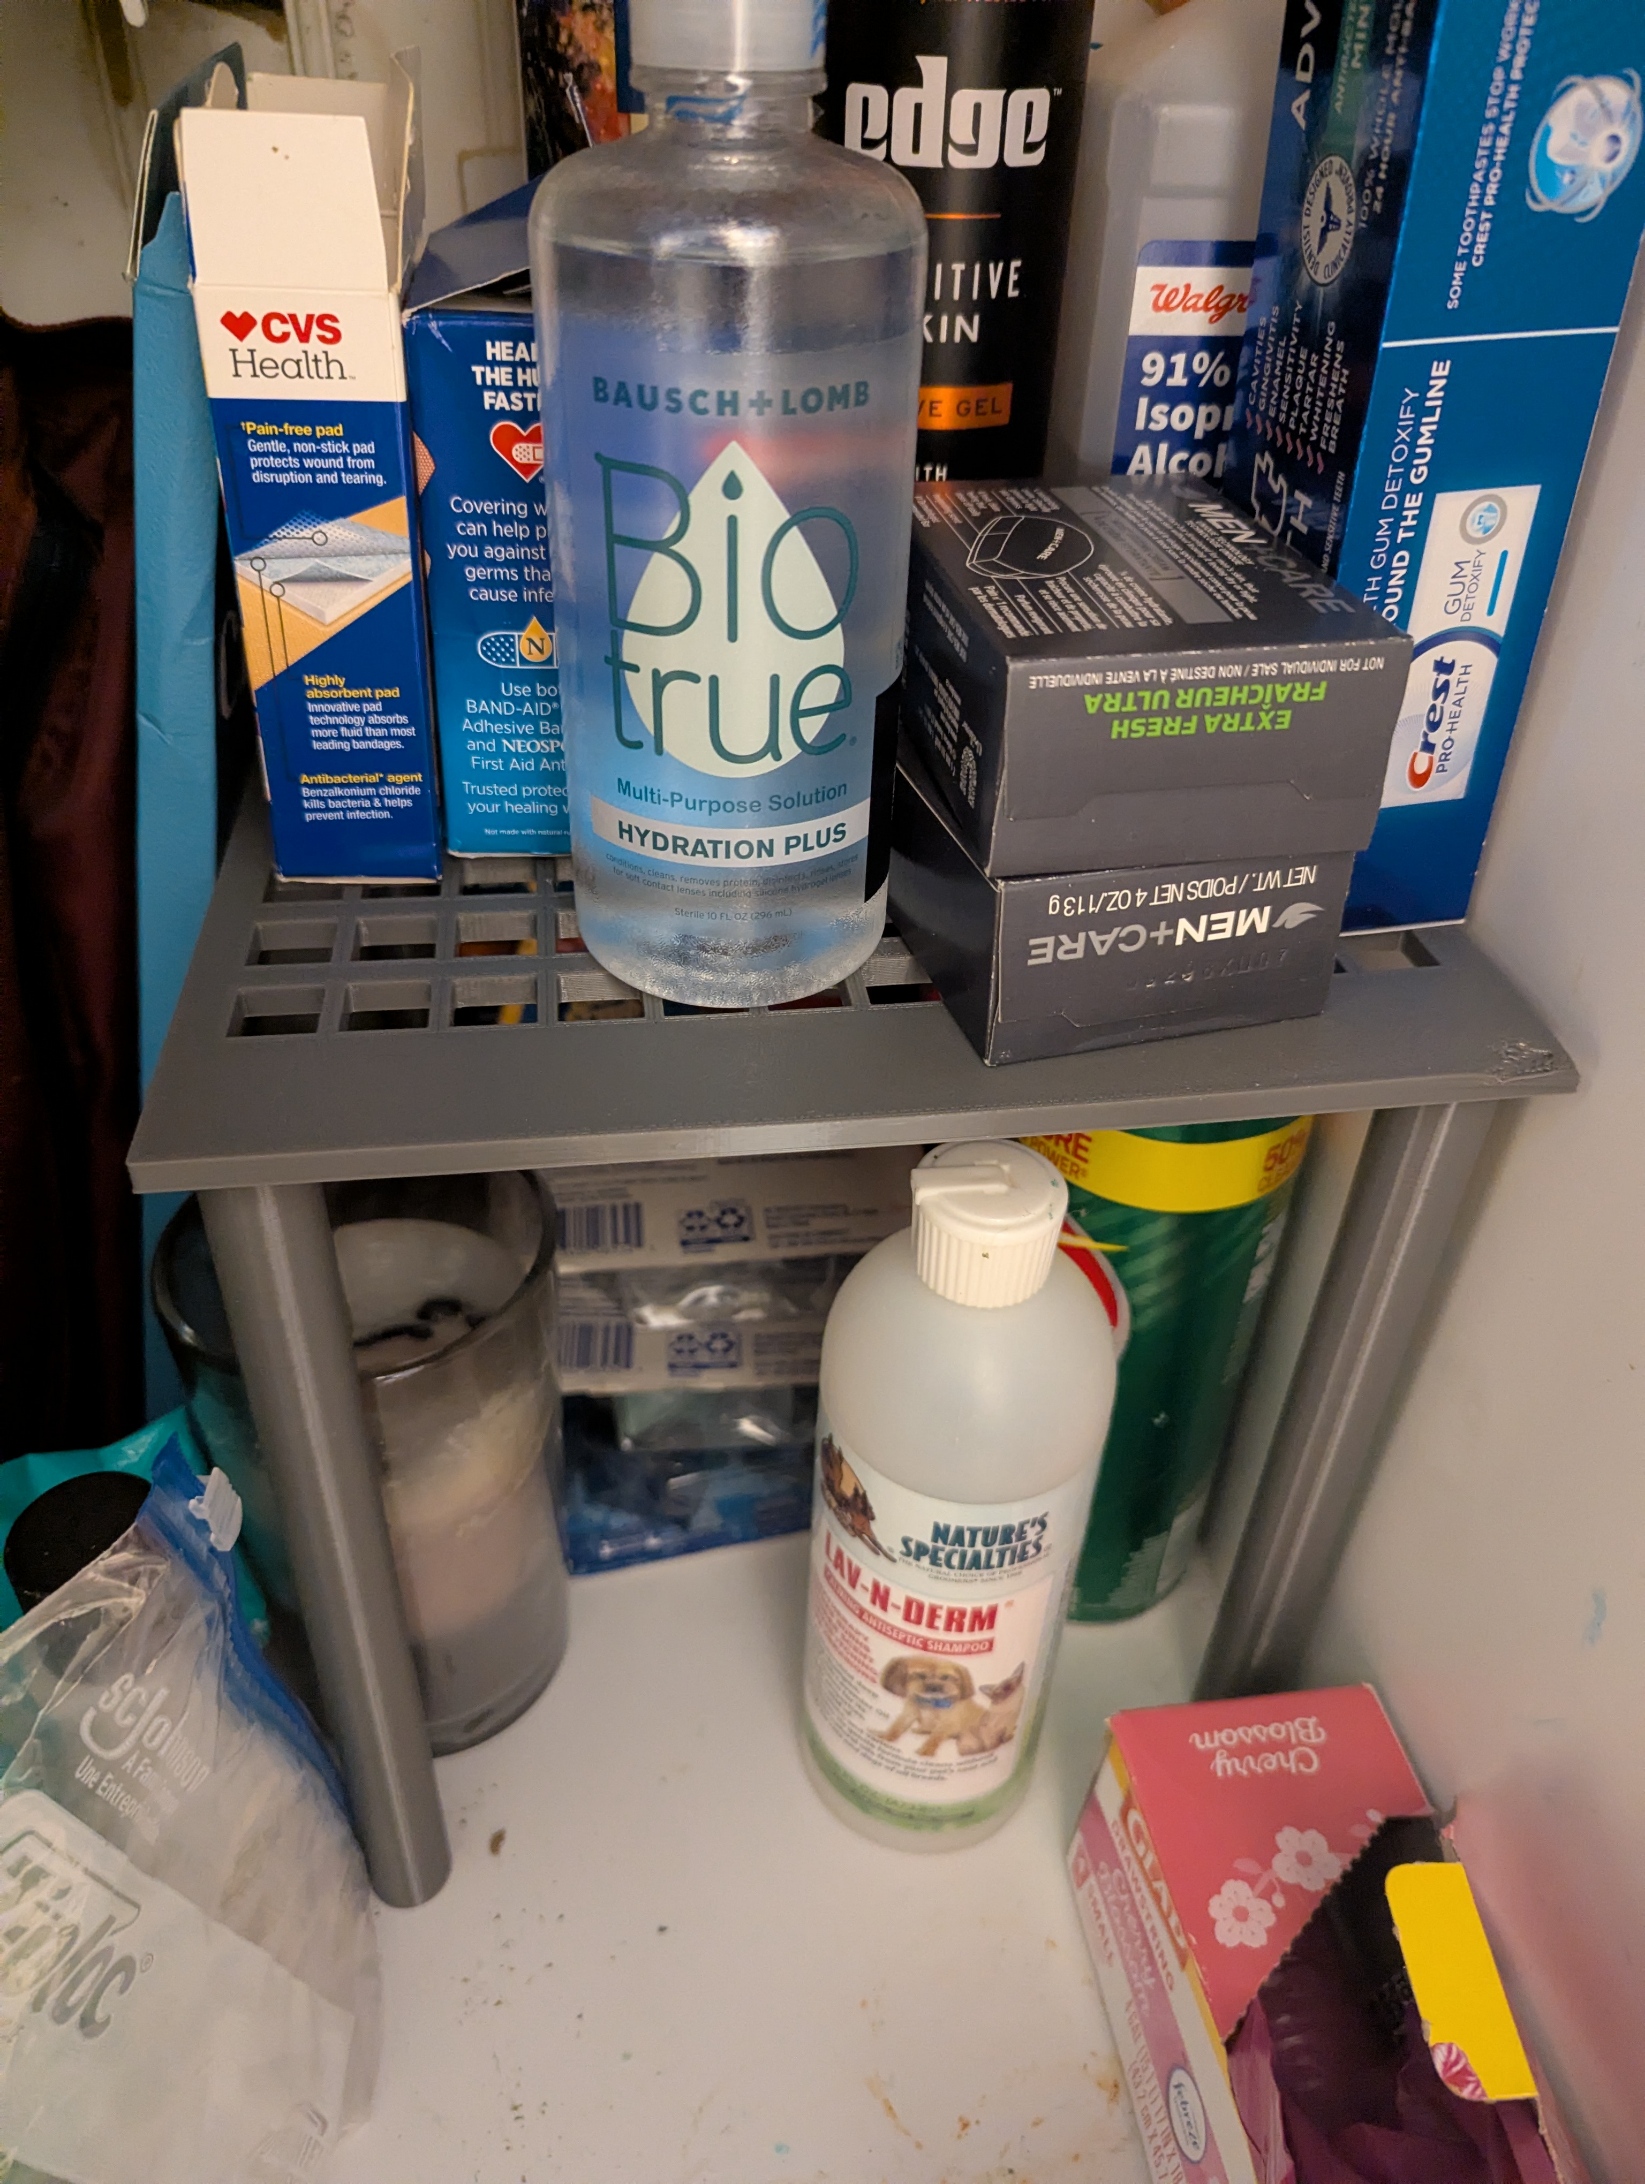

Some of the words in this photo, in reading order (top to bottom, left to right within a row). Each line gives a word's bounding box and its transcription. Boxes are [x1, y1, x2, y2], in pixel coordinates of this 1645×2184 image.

[1472, 212, 1493, 268] CREST
[1483, 84, 1522, 207] PRO-HEALTH
[1304, 159, 1334, 218] DESIGNED
[1447, 260, 1468, 310] SOME
[1458, 122, 1496, 258] TOOTHPASTES
[1484, 66, 1504, 120] STOP
[1303, 225, 1319, 277] DENTIST
[1324, 219, 1352, 279] CLINICALLY
[934, 259, 1023, 301] ITIVE
[1150, 283, 1256, 325] Walgr
[261, 312, 342, 345] CVS
[923, 313, 980, 344] KIN
[1140, 351, 1231, 388] 91%
[1249, 316, 1267, 405] CAVITIES
[1259, 305, 1279, 411] GINGIVITIS
[1279, 299, 1303, 424] SENSITIVITY
[471, 365, 513, 386] THE
[1269, 336, 1286, 418] ENAMEL
[1309, 321, 1336, 441] WHITENING
[592, 376, 871, 416] BAUSCH+LOMB
[1288, 346, 1308, 430] PLAQUE
[1299, 352, 1319, 435] TARTAR
[1320, 340, 1344, 450] FRESHENS
[956, 398, 1003, 418] GEL
[1328, 369, 1350, 454] BREATH
[315, 424, 344, 438] pad
[1409, 359, 1452, 485] GUMLINE
[248, 439, 290, 454] Gentle,
[293, 441, 349, 453] non-stick
[352, 441, 375, 456] pad
[1381, 387, 1420, 511] DETOXIFY
[250, 457, 300, 470] protects
[302, 457, 343, 469] wound
[347, 457, 375, 469] from
[252, 471, 312, 486] disruption
[316, 472, 338, 484] and
[341, 472, 387, 487] tearing.
[1333, 471, 1346, 502] TEETH
[450, 496, 528, 518] Covering
[1397, 492, 1423, 544] THE
[456, 522, 488, 536] can
[492, 520, 530, 540] help
[1327, 503, 1340, 553] SENSITIVE
[446, 543, 478, 559] you
[484, 544, 546, 561] against
[594, 452, 859, 643] Bio
[1370, 516, 1394, 569] GUM
[465, 566, 518, 582] germs
[524, 565, 551, 582] tha
[469, 588, 518, 602] cause
[1443, 559, 1471, 615] GUM
[1460, 549, 1487, 622] DETOXIFY
[1218, 664, 1242, 678] NON
[1251, 662, 1278, 677] SALE
[1282, 660, 1337, 675] INDIVIDUAL
[1339, 658, 1361, 672] FOR
[1363, 656, 1385, 671] NOT
[304, 675, 345, 687] Highly
[1028, 673, 1104, 690] INDIVIDUELLE
[1106, 669, 1141, 684] VENTE
[1143, 669, 1157, 682] LA
[306, 687, 373, 699] absorbent
[375, 687, 400, 700] pad
[501, 683, 532, 697] Use
[1084, 689, 1171, 714] ULTRA
[307, 701, 360, 712] Innovative
[363, 701, 382, 713] pad
[309, 715, 365, 726] technology
[368, 714, 409, 724] absorbs
[462, 719, 534, 735] Adhesive
[1110, 715, 1198, 740] FRESH
[1204, 709, 1292, 734] EXTRA
[1406, 656, 1457, 790] Crest
[311, 728, 338, 738] more
[340, 727, 363, 737] fluid
[365, 727, 388, 737] than
[390, 726, 416, 737] most
[312, 739, 350, 751] leading
[352, 739, 404, 751] bandages.
[467, 739, 496, 752] and
[471, 756, 504, 771] First
[510, 758, 534, 771] Aid
[387, 772, 423, 784] agent
[302, 786, 376, 798] Benzalkonium
[379, 785, 421, 795] chloride
[462, 782, 518, 796] Trusted
[522, 786, 567, 798] protec
[617, 777, 762, 817] Multi-Purpose
[768, 782, 847, 811] Solution
[304, 799, 326, 809] kills
[329, 798, 371, 808] bacteria
[374, 799, 382, 807] &
[384, 798, 413, 809] helps
[468, 803, 501, 815] your
[505, 801, 558, 816] healing
[305, 810, 344, 822] prevent
[346, 809, 393, 820] infection.
[618, 820, 775, 860] HYDRATION
[784, 822, 847, 856] PLUS
[642, 878, 674, 892] contact
[677, 886, 706, 897] lenses
[680, 876, 720, 886] removes
[1252, 871, 1284, 893] WT.
[1284, 865, 1318, 887] NET
[1136, 888, 1149, 905] 4
[1150, 883, 1187, 906] NET
[1189, 877, 1237, 901] POIDS
[674, 907, 704, 919] Sterile
[720, 912, 731, 921] FL
[1048, 894, 1060, 916] g
[1027, 905, 1273, 966] MEN+CARE
[931, 1511, 1049, 1548] NATURE'S
[899, 1534, 1044, 1570] SPECIALTIES
[824, 1529, 999, 1633] LAV-N-DERM
[860, 1612, 924, 1648] ANTISEPTIC
[926, 1639, 989, 1653] SHAMPOO
[1189, 1716, 1326, 1751] Blossom
[1211, 1747, 1319, 1778] Cherry
